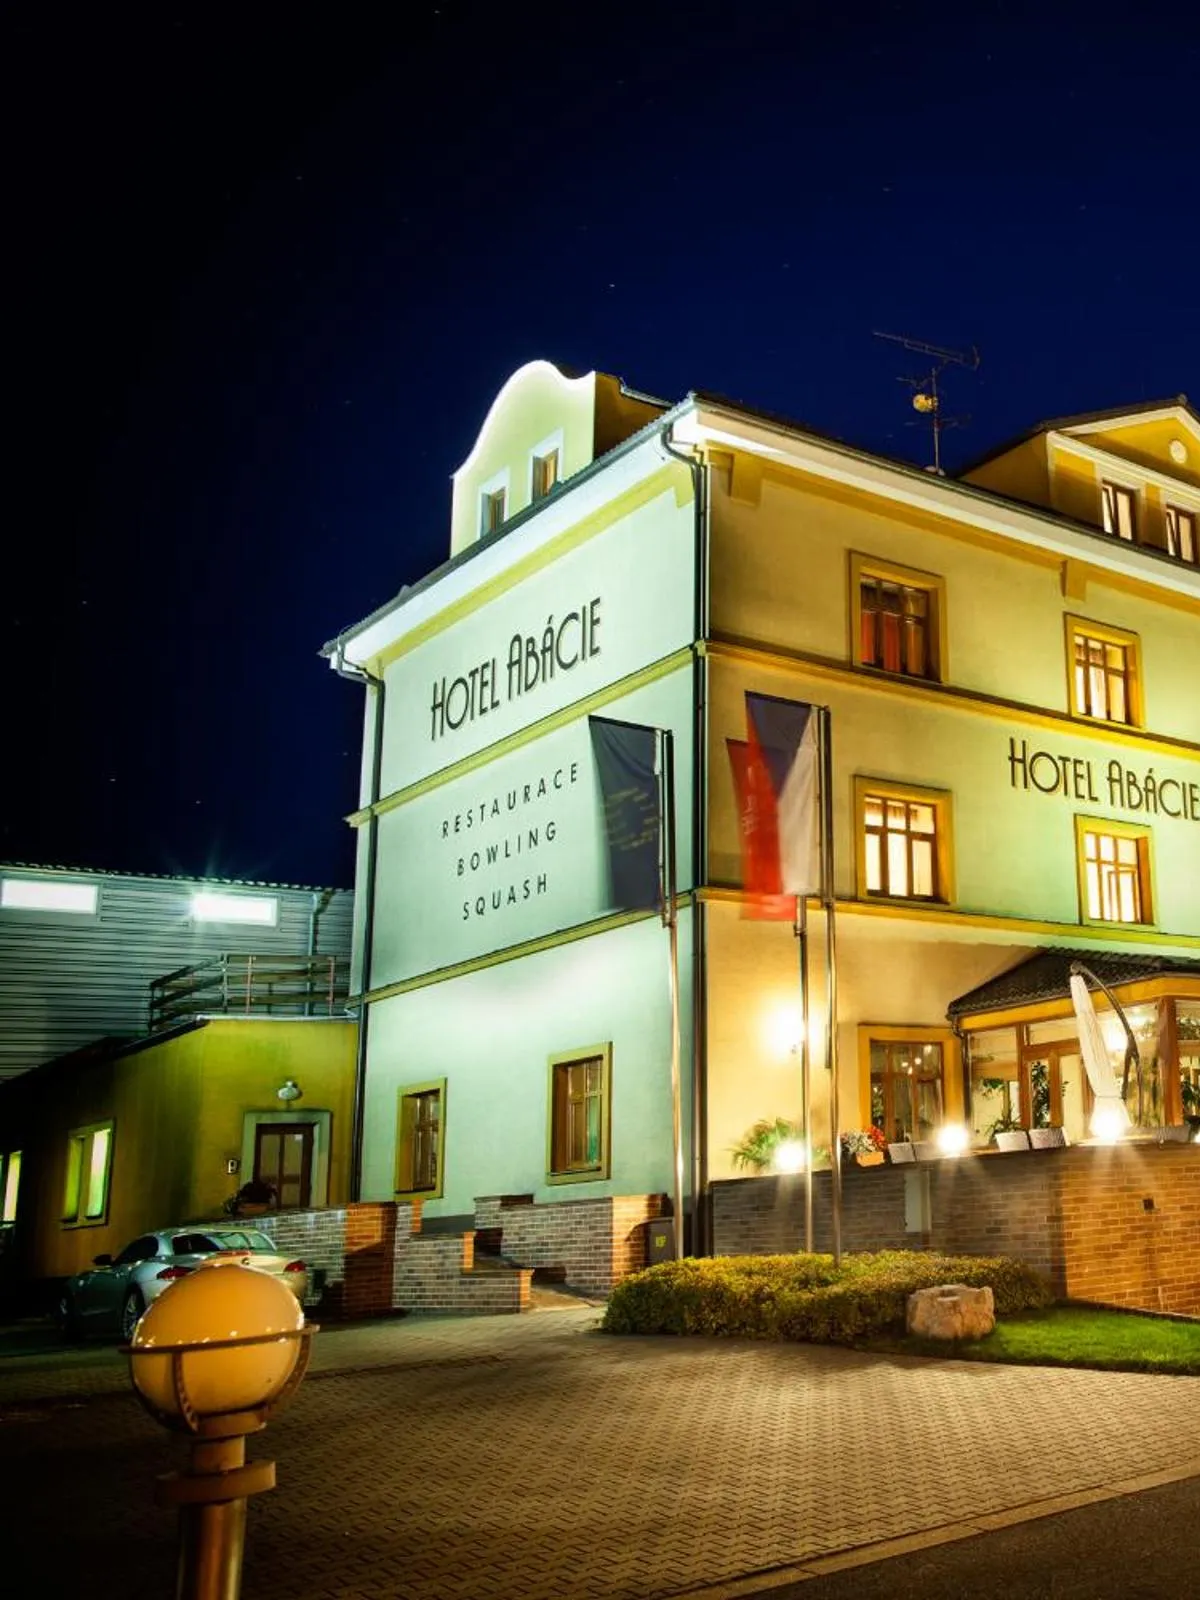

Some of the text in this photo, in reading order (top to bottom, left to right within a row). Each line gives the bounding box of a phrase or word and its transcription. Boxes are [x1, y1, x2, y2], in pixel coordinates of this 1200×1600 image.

[431, 597, 602, 741] HOTEL ABÁCIE
[441, 762, 578, 839] RESTAURACE
[1008, 737, 1200, 821] HOTEL ABÁCIE
[456, 821, 557, 877] BOWLING
[462, 873, 548, 921] SQUASH
